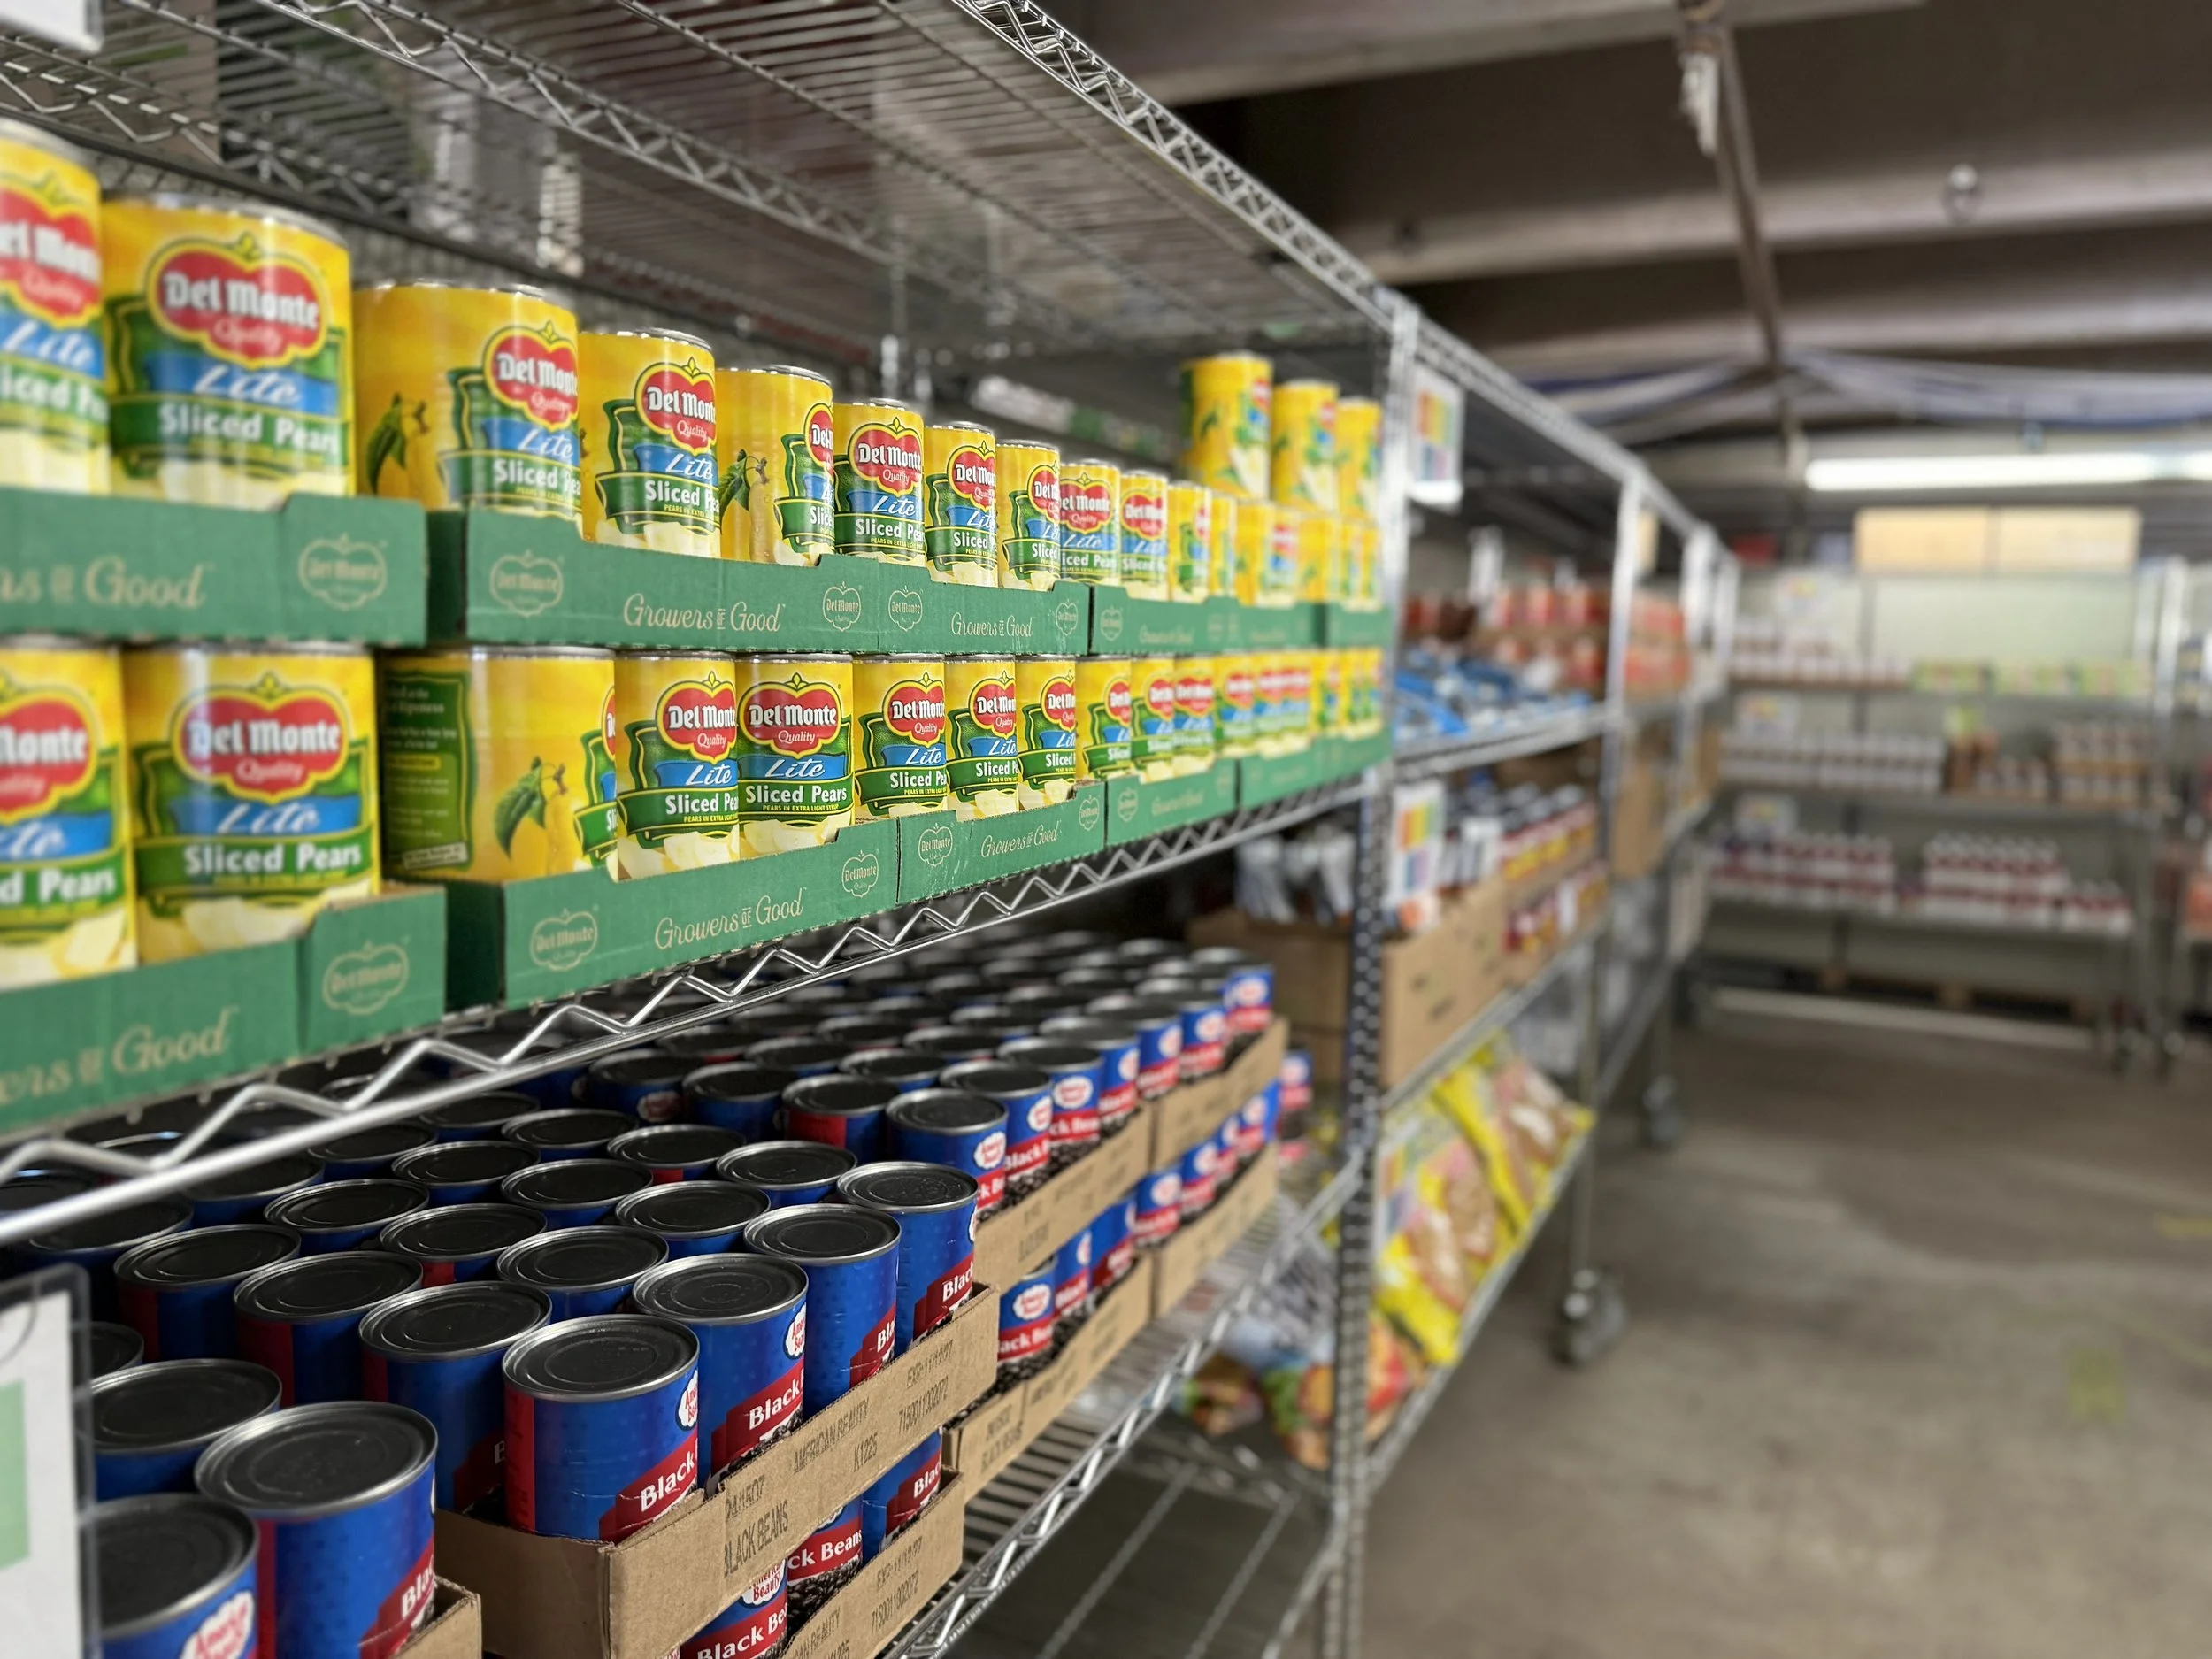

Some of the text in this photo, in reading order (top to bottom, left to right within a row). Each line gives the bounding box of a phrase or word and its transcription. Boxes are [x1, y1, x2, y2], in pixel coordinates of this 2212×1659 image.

[162, 270, 319, 331] Del Monte
[191, 363, 302, 408] Lite
[495, 352, 578, 397] Del Mont
[647, 386, 681, 415] Del
[159, 403, 264, 442] Sliced
[677, 419, 709, 442] Quality
[517, 427, 574, 462] Lite
[858, 442, 885, 464] Del
[494, 458, 559, 490] Sliced
[666, 452, 713, 484] Lite
[882, 468, 910, 487] Quality
[956, 464, 978, 483] Del
[644, 479, 701, 508] Sliced
[810, 506, 833, 526] Slice
[872, 495, 917, 516] Lite
[855, 518, 902, 541] Sliced
[954, 532, 989, 549] Sliced
[1062, 553, 1088, 567] iced
[84, 553, 204, 610] Good
[623, 593, 714, 632] Growers
[730, 601, 780, 632] Good
[838, 599, 858, 613] Monte
[950, 612, 997, 637] Growers
[1007, 615, 1033, 637] Good
[891, 700, 918, 719] Del
[977, 696, 1000, 714] Del
[1048, 693, 1065, 710] Del
[668, 705, 701, 729] Del
[749, 704, 837, 726] Del Monte
[187, 718, 340, 757] Del Monte
[697, 732, 726, 749] Quality
[778, 729, 816, 744] Quality
[914, 722, 938, 736] Quality
[764, 758, 826, 779] Lite
[905, 748, 942, 766] Lite
[1045, 754, 1072, 770] Sliced
[686, 763, 733, 786] Lite
[890, 771, 933, 789] Sliced
[976, 761, 1010, 779] Sliced
[665, 794, 719, 816] Sliced
[745, 785, 848, 803] Sliced Pears
[216, 803, 320, 835] Lite
[683, 815, 703, 824] PEARS
[921, 836, 951, 851] Del Monte
[980, 834, 1026, 857] Growers
[1033, 821, 1059, 846] Good
[182, 844, 284, 876] Sliced
[844, 866, 876, 882] Del Monte
[653, 917, 740, 950] Growers
[754, 894, 803, 926] Good
[111, 1005, 230, 1077] Good
[749, 1378, 801, 1431] Black
[837, 1396, 870, 1441] BEAUTY
[853, 1432, 879, 1473] K1225
[640, 1450, 696, 1511] Black
[757, 1499, 788, 1550] BEANS
